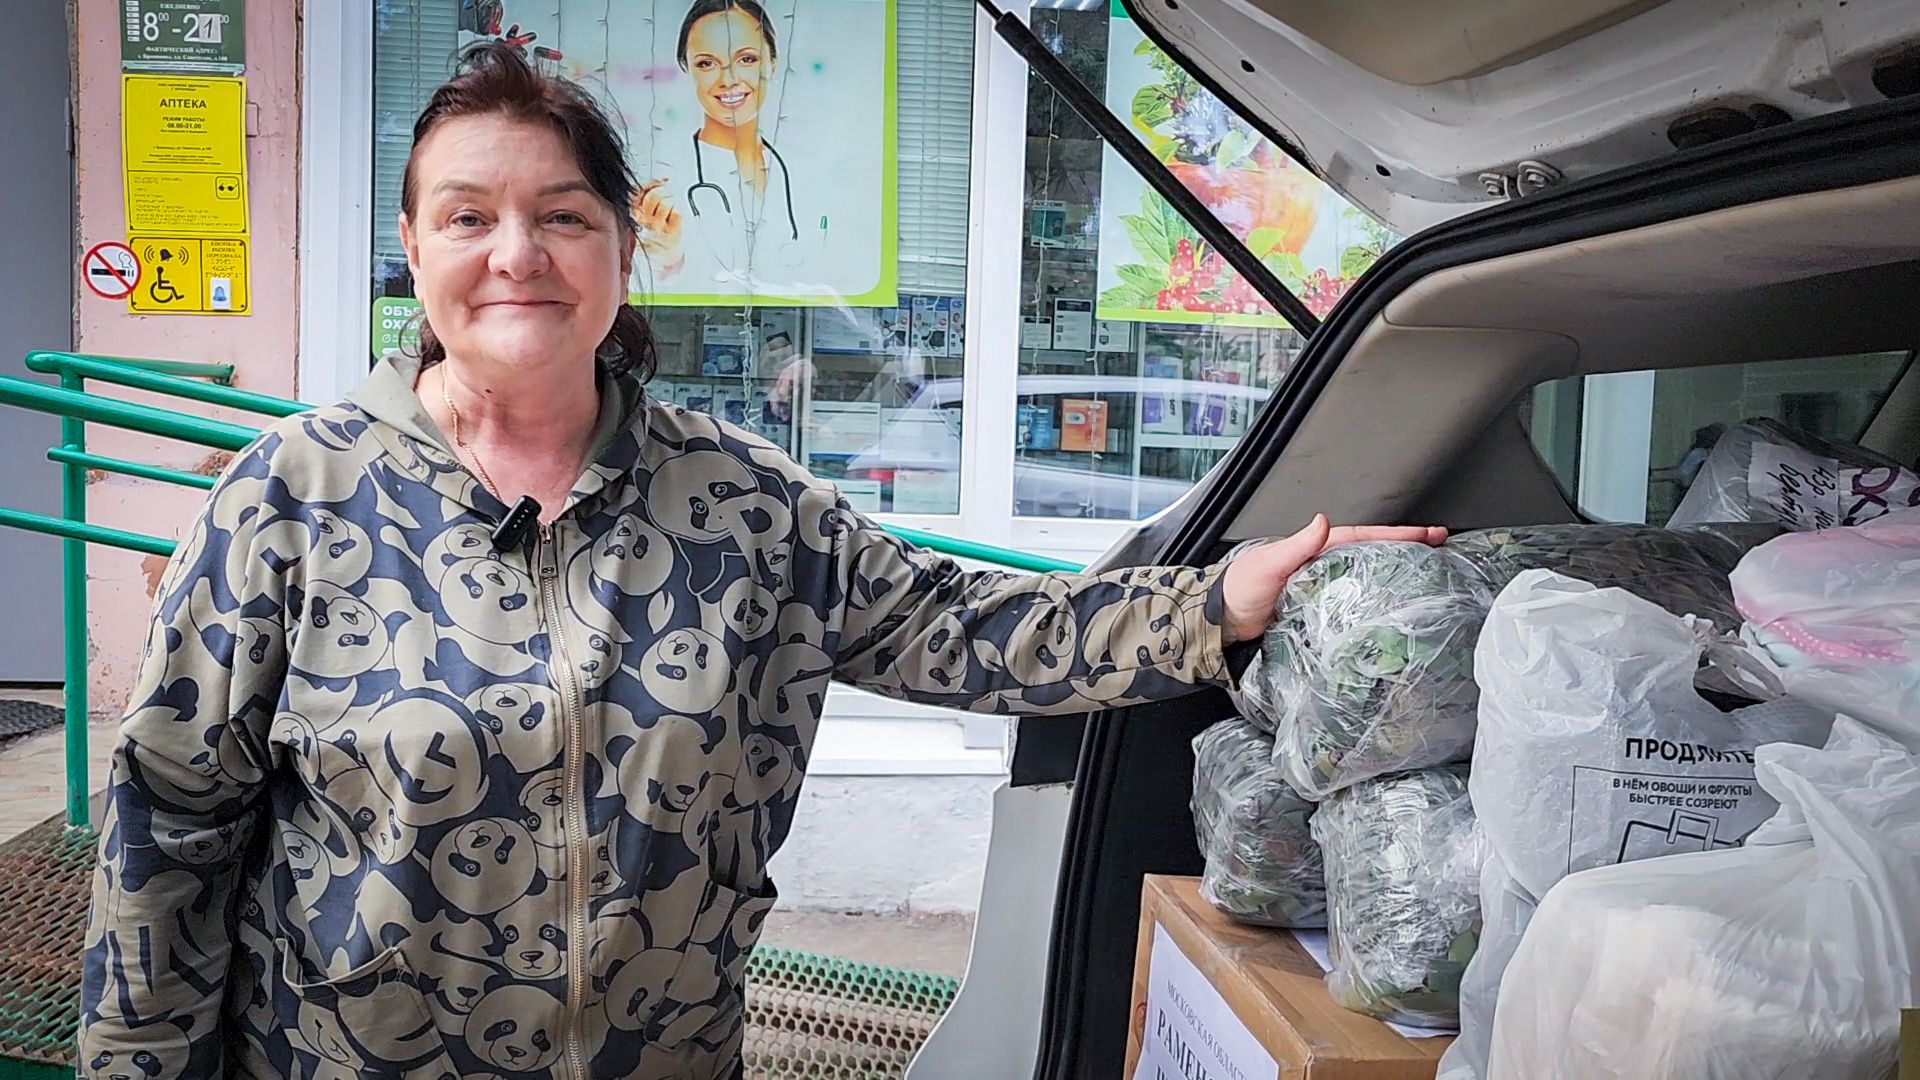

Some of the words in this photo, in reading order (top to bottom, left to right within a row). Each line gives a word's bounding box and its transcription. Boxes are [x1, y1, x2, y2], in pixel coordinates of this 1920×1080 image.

[159, 99, 207, 109] АПТЕКА
[1612, 778, 1621, 788] В
[1622, 778, 1649, 791] НЁМ
[1650, 781, 1696, 795] ОВОЩИ
[1698, 785, 1707, 795] И
[1707, 785, 1753, 796] ФРУКТЫ
[1629, 793, 1684, 807] БЫСТРЕЕ
[1685, 797, 1739, 809] СОЗРЕЮТ
[1167, 979, 1214, 1051] МОСКОВСКАЯ
[1213, 1040, 1248, 1080] ОБЛАСТ
[1156, 1007, 1213, 1080] РАМЕН
